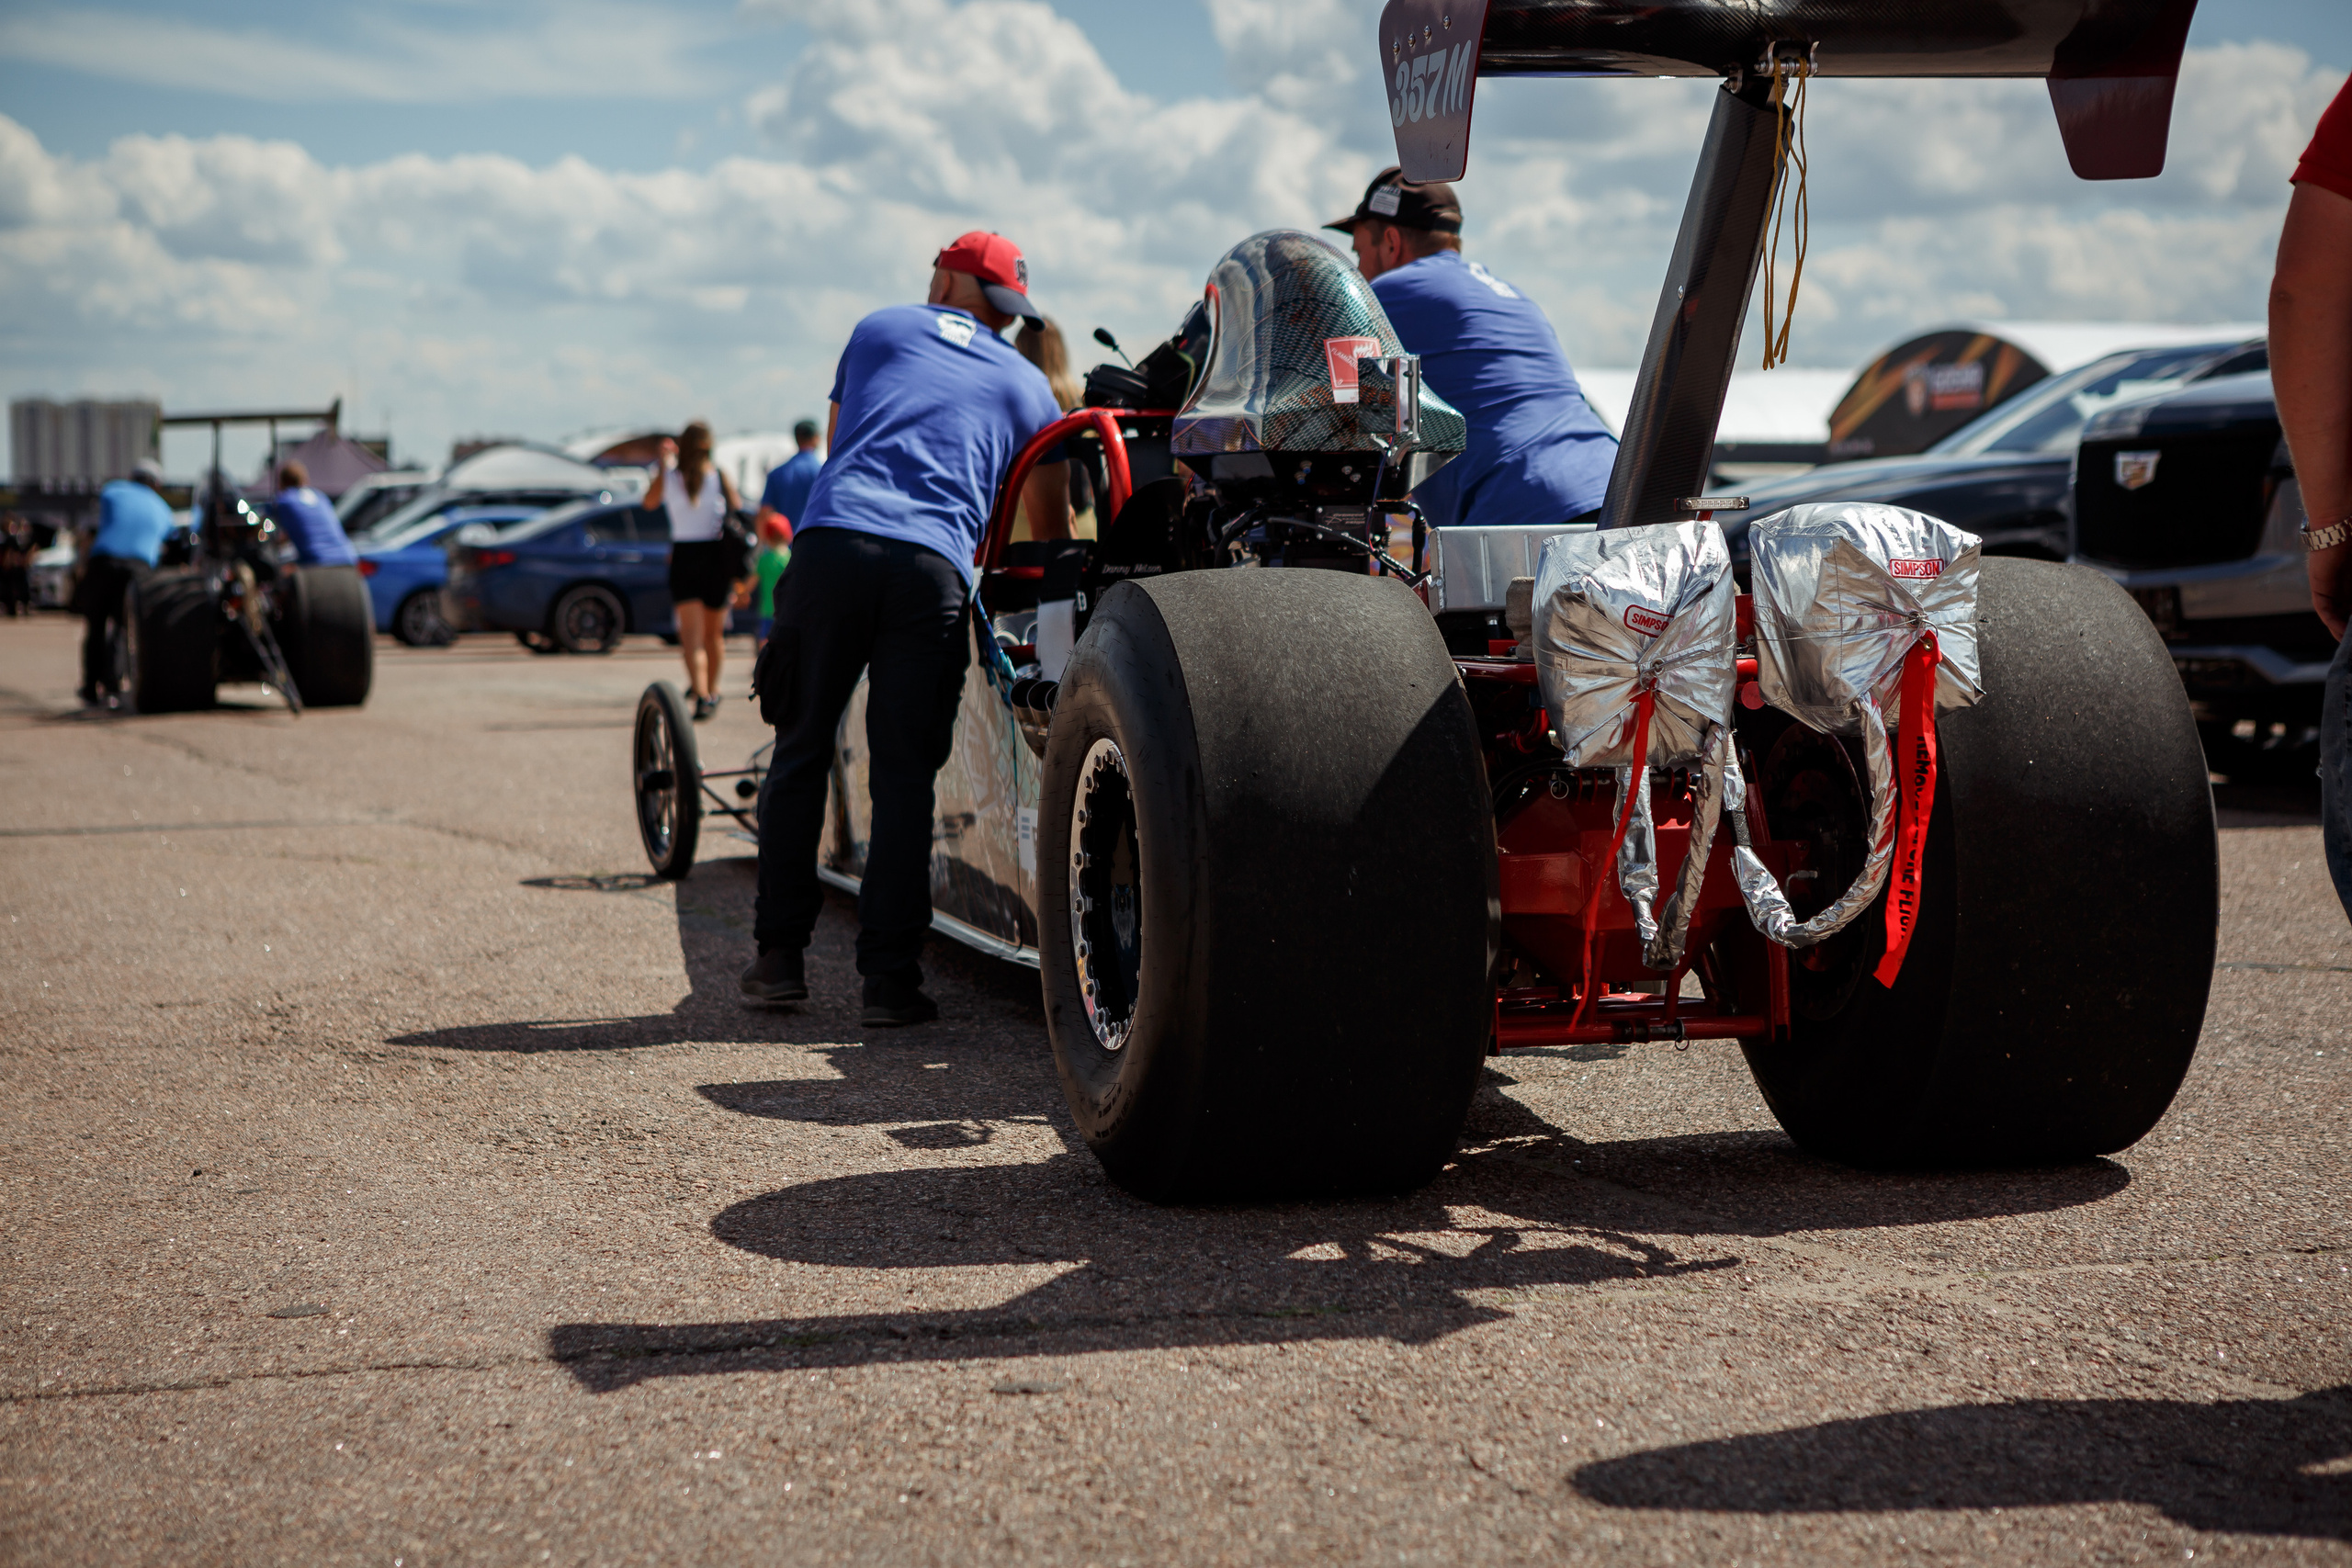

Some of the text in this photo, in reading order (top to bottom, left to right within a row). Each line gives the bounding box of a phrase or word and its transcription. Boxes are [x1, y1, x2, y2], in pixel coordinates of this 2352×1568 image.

[1392, 39, 1472, 128] 357M
[1894, 560, 1940, 576] SIMPSON
[1631, 613, 1670, 632] SIMPSO
